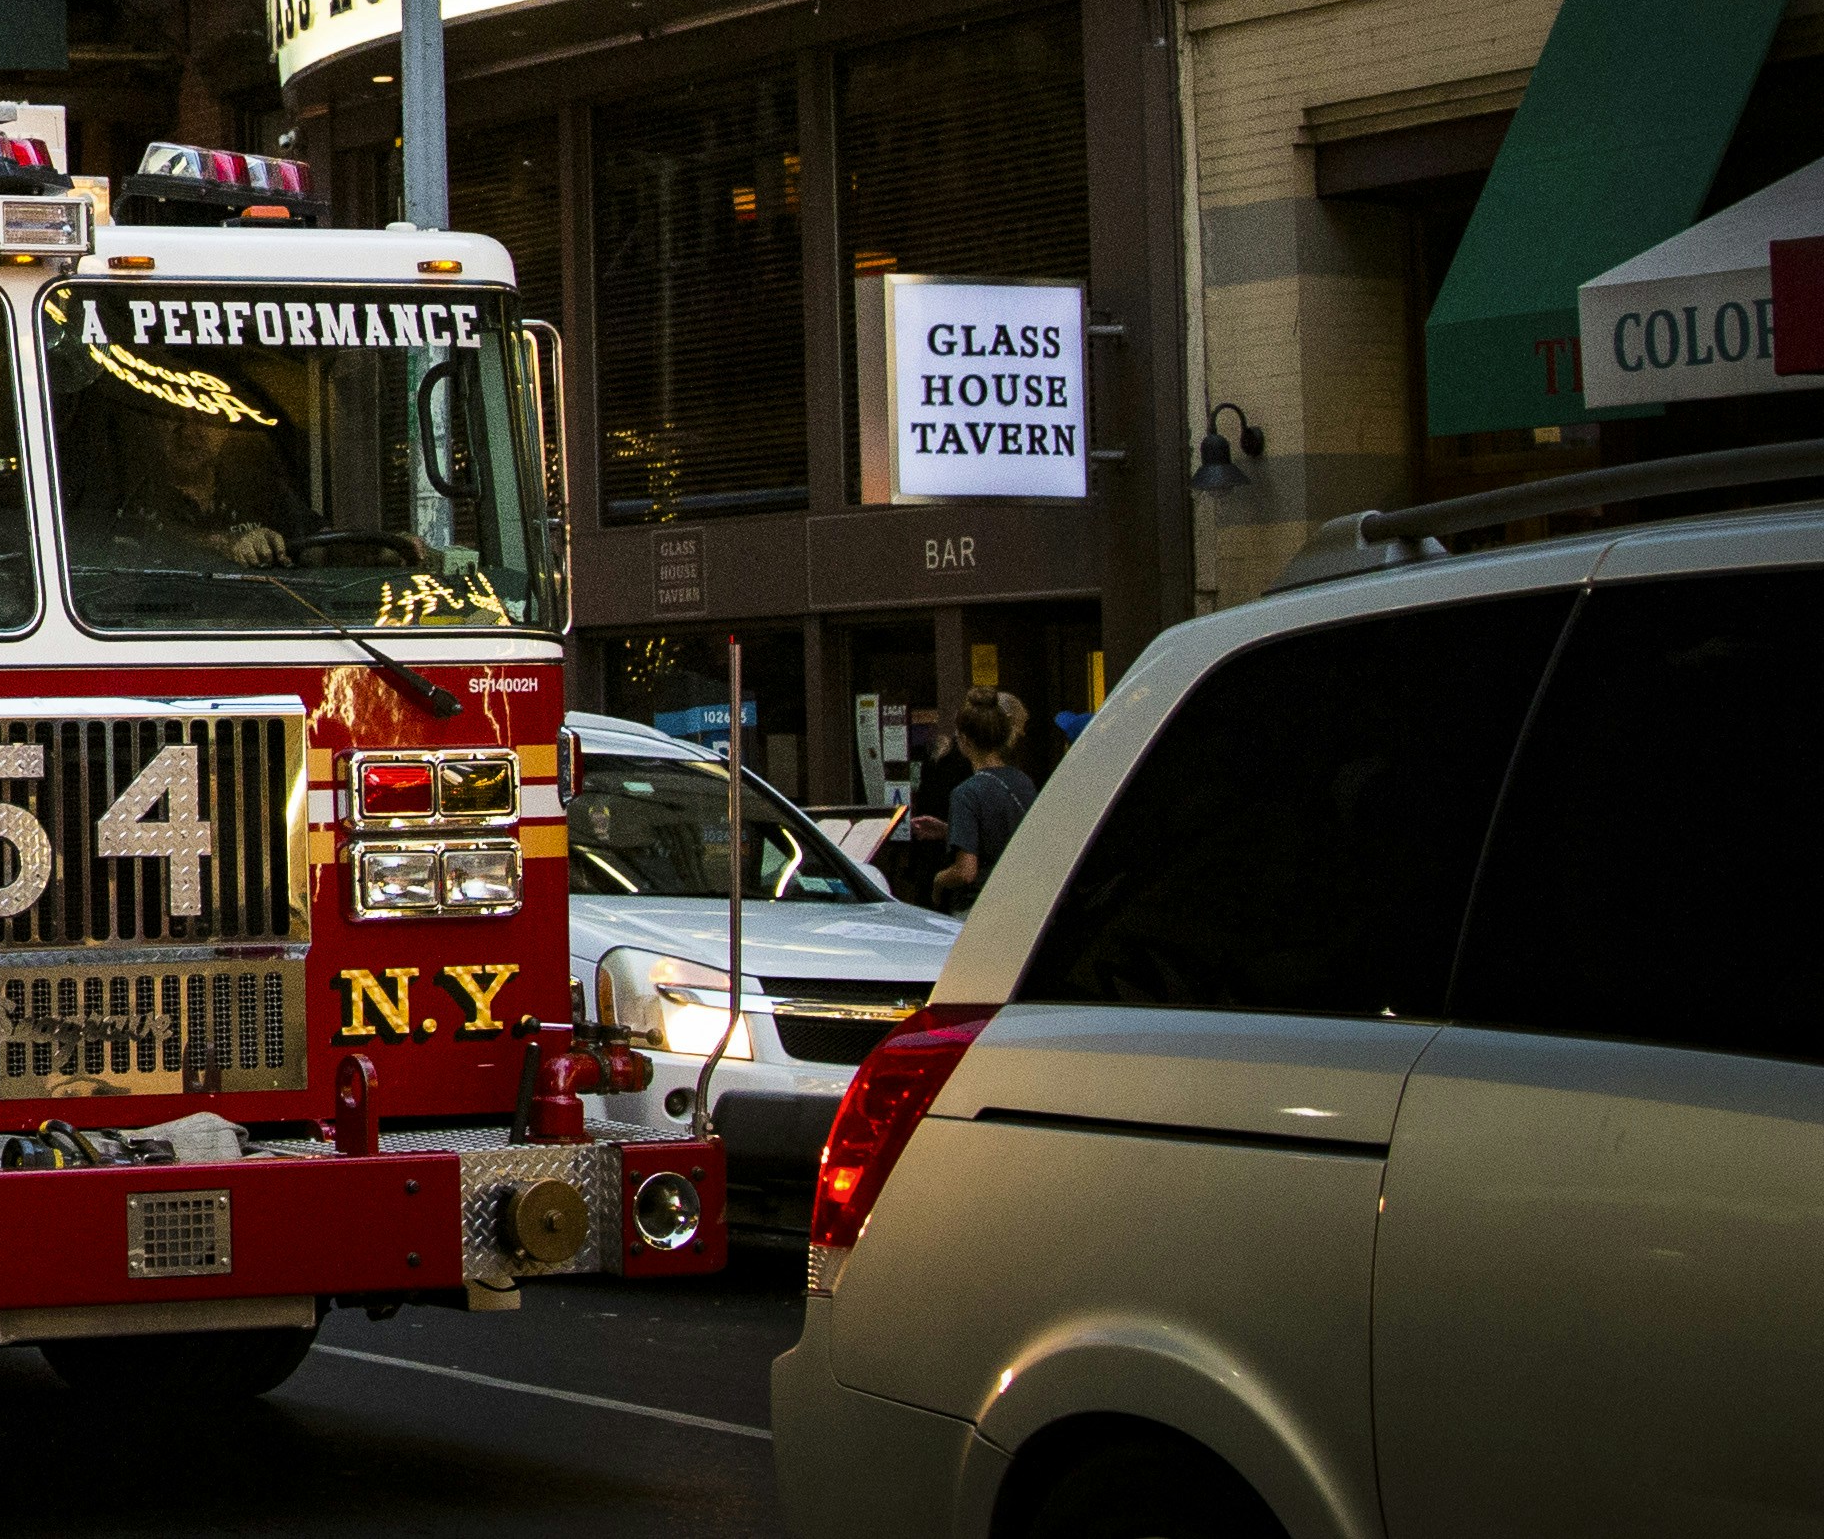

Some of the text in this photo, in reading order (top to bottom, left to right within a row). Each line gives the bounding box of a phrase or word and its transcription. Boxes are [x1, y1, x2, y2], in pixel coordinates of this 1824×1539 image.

[81, 300, 482, 348] A PERFORMANCE
[927, 323, 1061, 358] GLASS
[921, 374, 1068, 409] HOUSE
[911, 421, 1077, 457] TAVERN
[660, 540, 697, 557] GLASS
[924, 536, 976, 569] BAR
[659, 563, 698, 581] HOUSE
[657, 587, 700, 604] TAVERN
[468, 677, 538, 693] SP14002H
